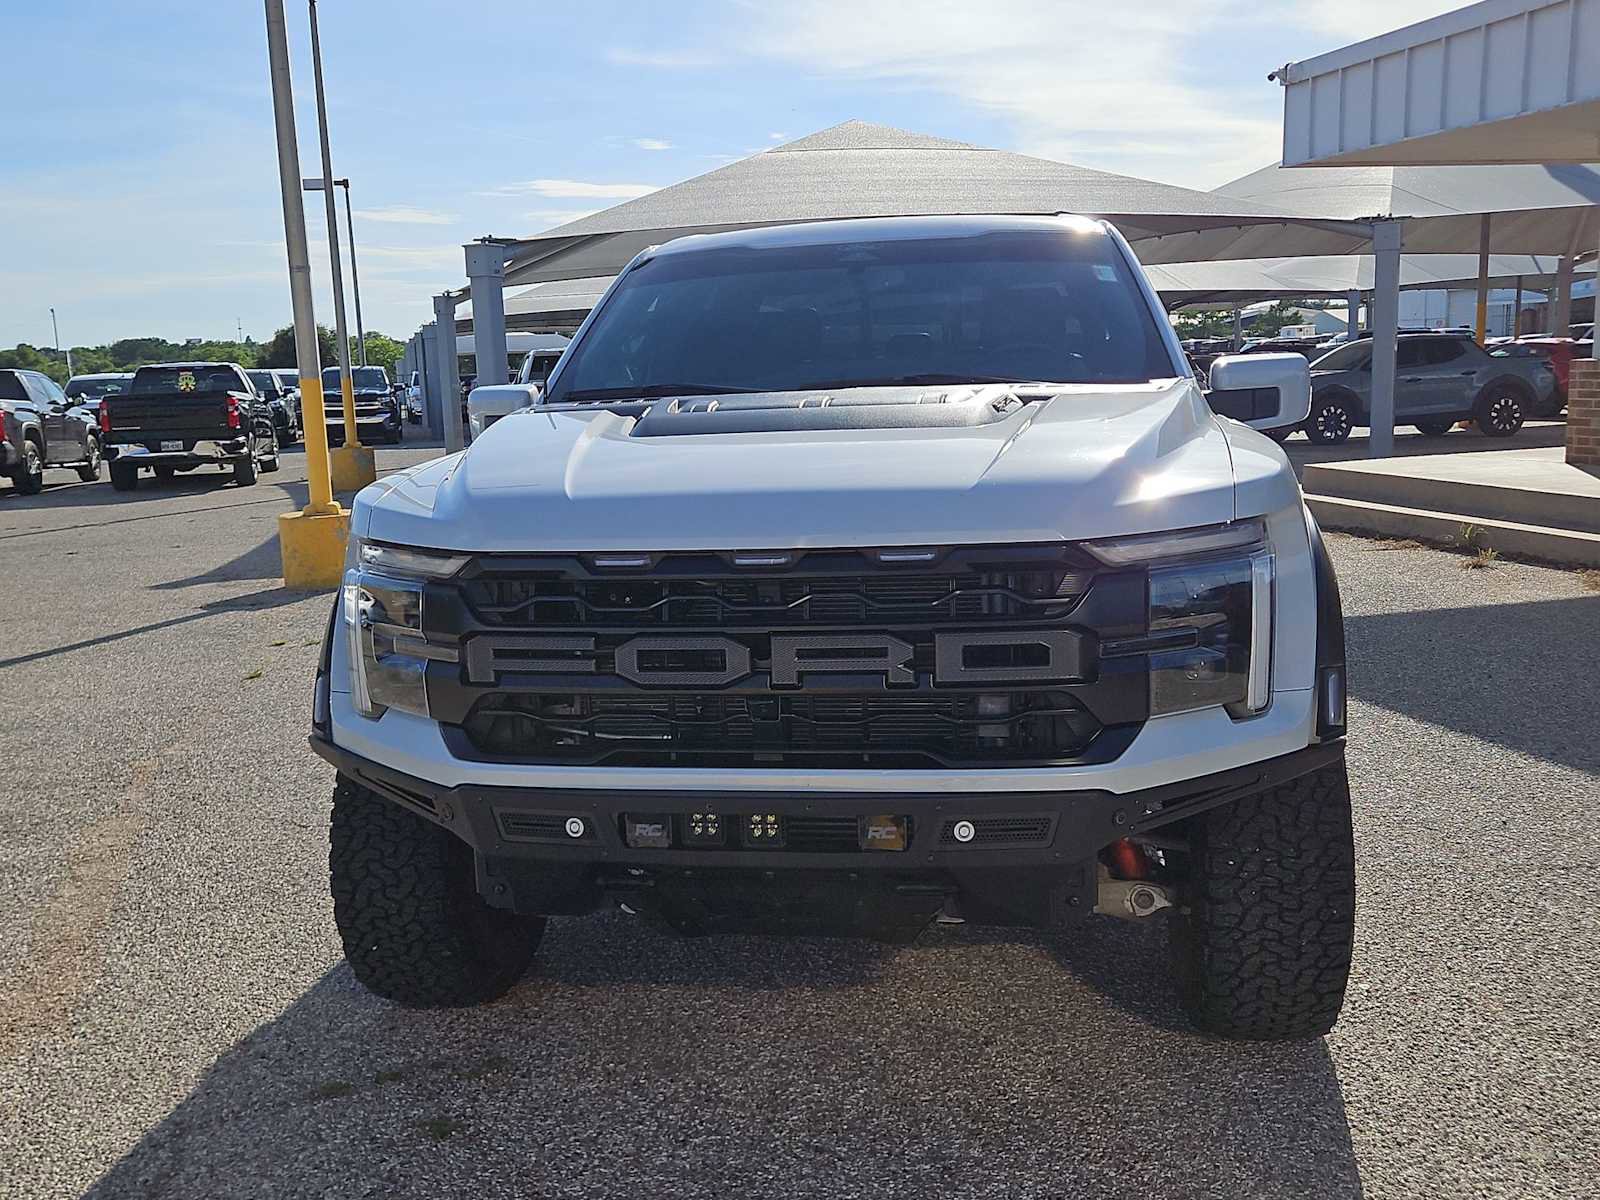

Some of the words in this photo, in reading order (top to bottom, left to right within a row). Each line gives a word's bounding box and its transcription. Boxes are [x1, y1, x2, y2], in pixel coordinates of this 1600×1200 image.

[466, 629, 1084, 686] FORD
[634, 823, 663, 837] RC
[867, 826, 897, 840] RC
